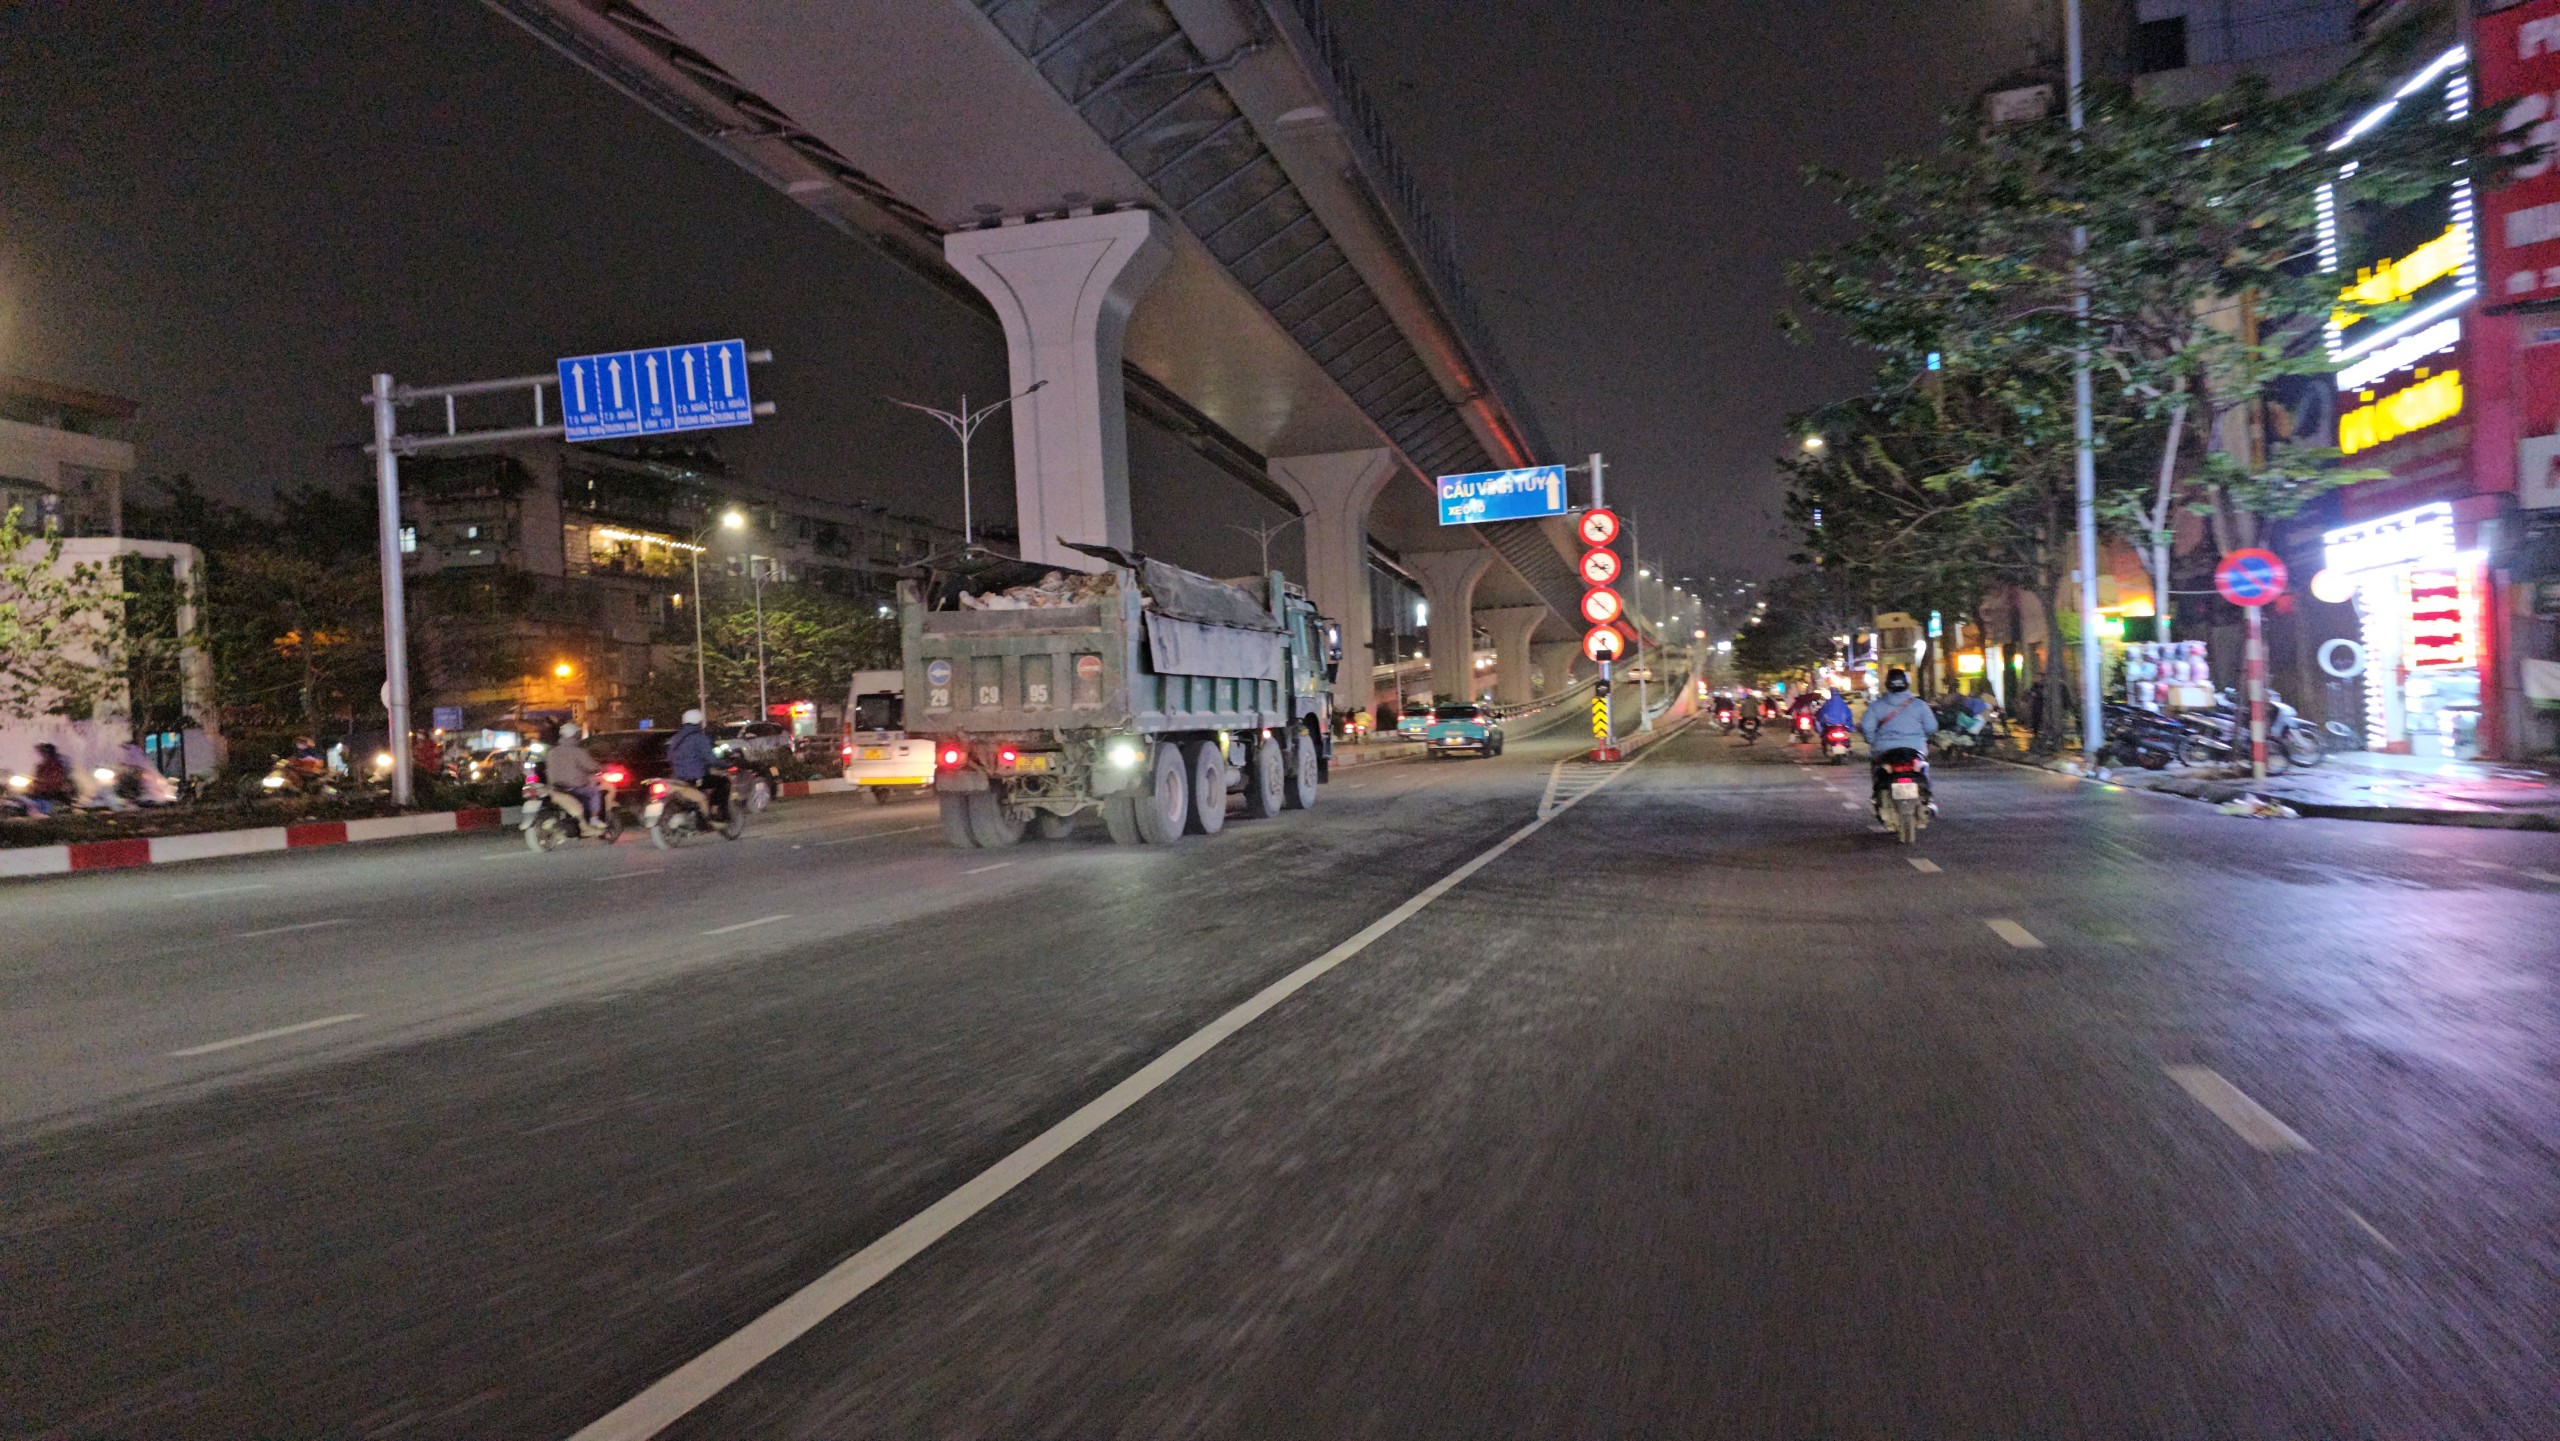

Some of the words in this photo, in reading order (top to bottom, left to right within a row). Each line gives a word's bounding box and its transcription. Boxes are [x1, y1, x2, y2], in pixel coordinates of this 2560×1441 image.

[930, 689, 949, 706] 29
[979, 686, 999, 704] C9
[1029, 684, 1048, 702] 95
